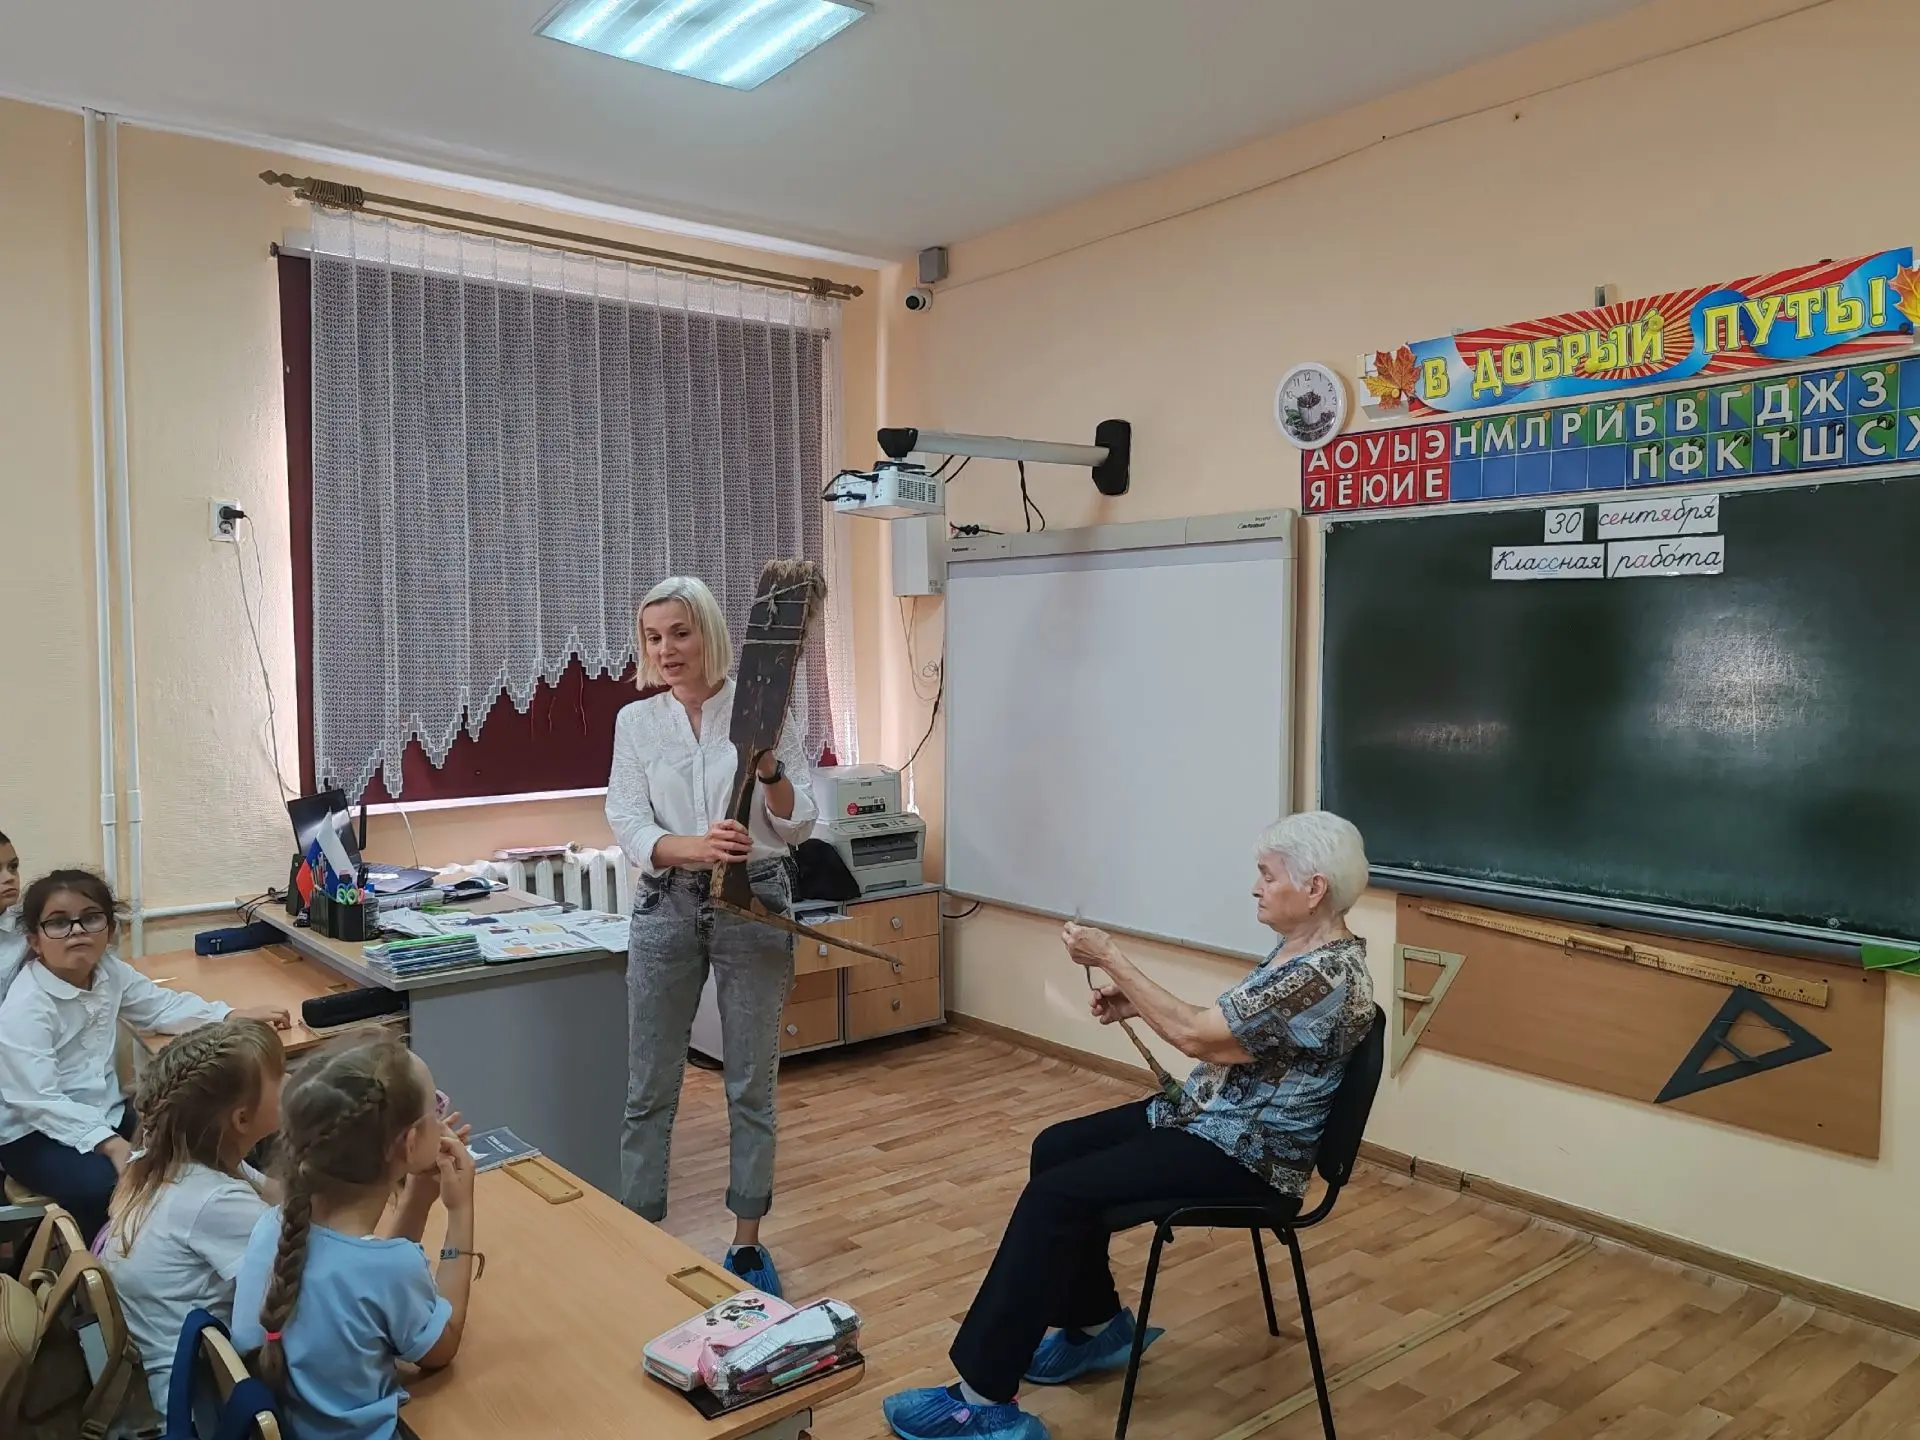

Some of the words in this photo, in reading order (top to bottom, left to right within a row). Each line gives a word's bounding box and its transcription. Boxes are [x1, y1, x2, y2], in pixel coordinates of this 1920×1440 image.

[1423, 356, 1450, 400] В
[1472, 308, 1666, 399] ДОБРЫЙ
[1703, 276, 1887, 355] ПУТЬ!
[1308, 448, 1329, 472] А
[1335, 440, 1358, 469] О
[1365, 436, 1385, 466] У
[1394, 433, 1416, 463] Ы
[1425, 430, 1445, 459] Э
[1455, 425, 1477, 456] Н
[1484, 421, 1514, 453] М
[1521, 416, 1545, 448] Л
[1562, 413, 1582, 444] Р
[1596, 405, 1623, 441] Й
[1635, 402, 1657, 437] Б
[1676, 398, 1698, 431] В
[1721, 391, 1743, 426] Г
[1756, 384, 1793, 426] Д
[1802, 378, 1844, 416] Ж
[1858, 371, 1887, 408] З
[1310, 480, 1326, 508] Я
[1338, 473, 1353, 505] Ё
[1362, 474, 1387, 503] Ю
[1393, 471, 1414, 501] И
[1426, 468, 1443, 498] Е
[1633, 446, 1658, 480] П
[1669, 442, 1703, 474] Ф
[1717, 436, 1744, 471] К
[1763, 431, 1790, 466] Т
[1802, 424, 1843, 462] Ш
[1857, 420, 1887, 456] С
[1493, 550, 1602, 572] Классная
[1549, 511, 1582, 534] 30
